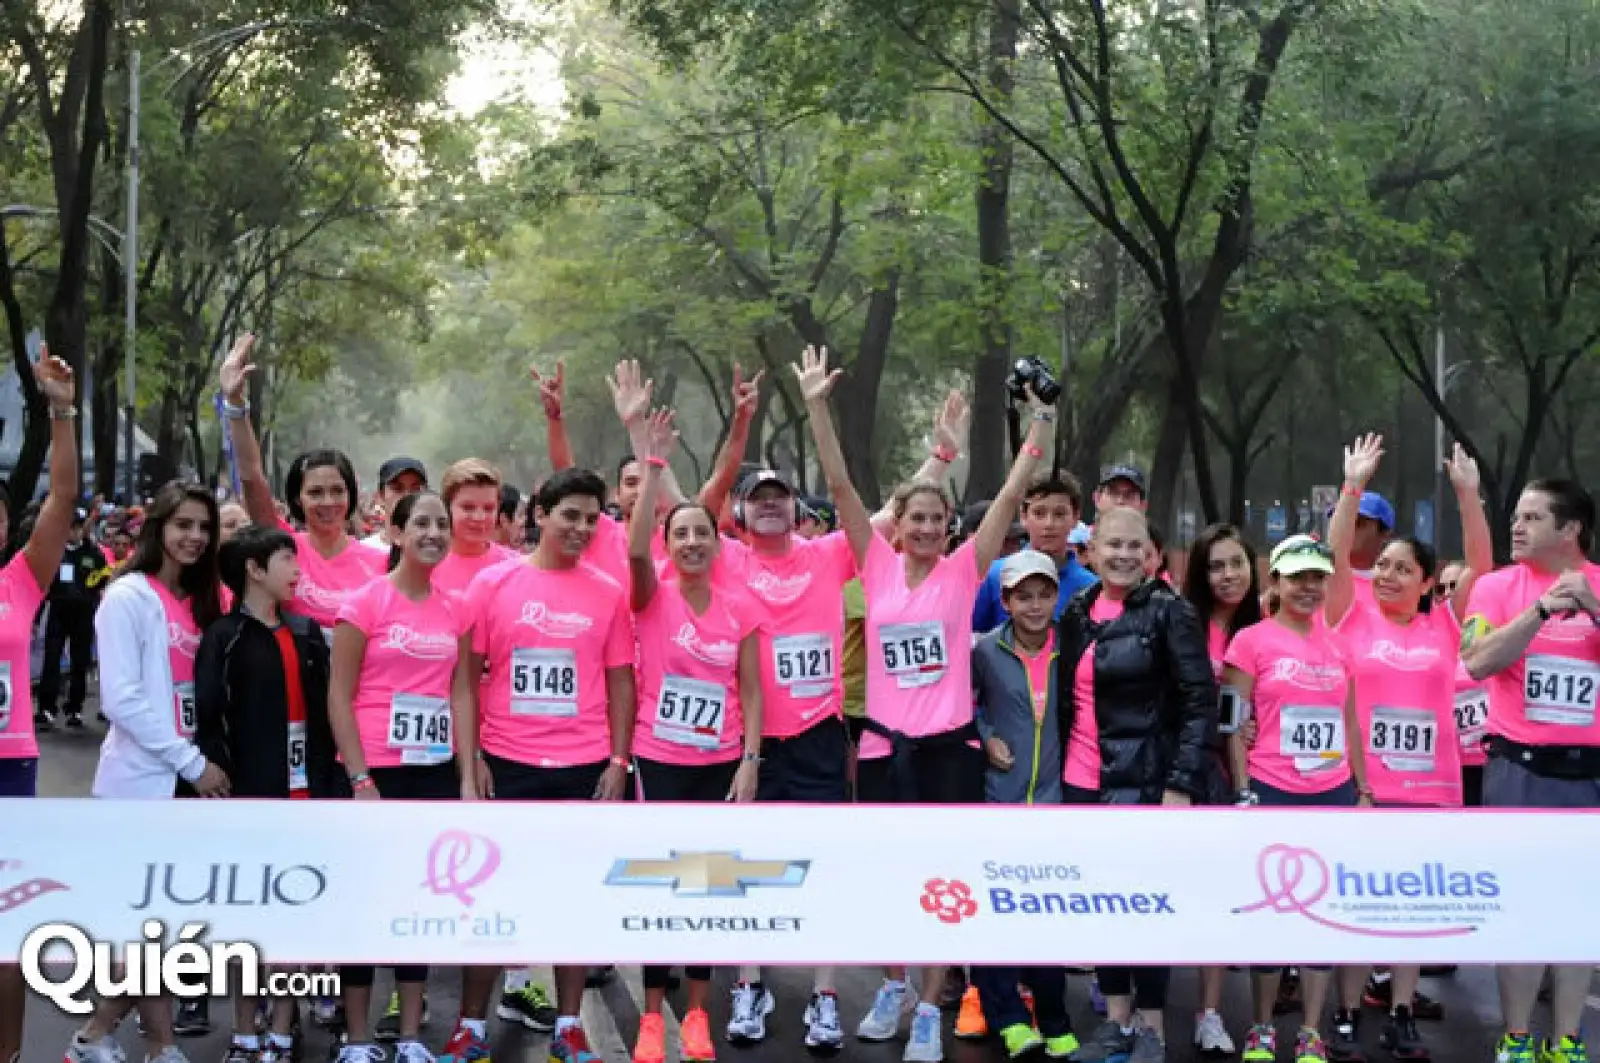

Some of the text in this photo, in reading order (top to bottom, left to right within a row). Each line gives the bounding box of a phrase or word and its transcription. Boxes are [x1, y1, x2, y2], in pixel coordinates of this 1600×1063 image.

[777, 647, 831, 679] 5121
[883, 636, 943, 669] 5154
[514, 664, 575, 696] 5148
[1527, 670, 1593, 705] 5412
[659, 689, 721, 728] 5177
[392, 712, 448, 744] 5149
[1291, 722, 1336, 751] 437
[1372, 721, 1434, 752] 3191
[131, 863, 326, 910] JULIO
[983, 860, 1081, 883] Seguros
[1336, 863, 1500, 897] huellas
[989, 887, 1175, 914] Banamex
[622, 916, 805, 931] CHEVROLET
